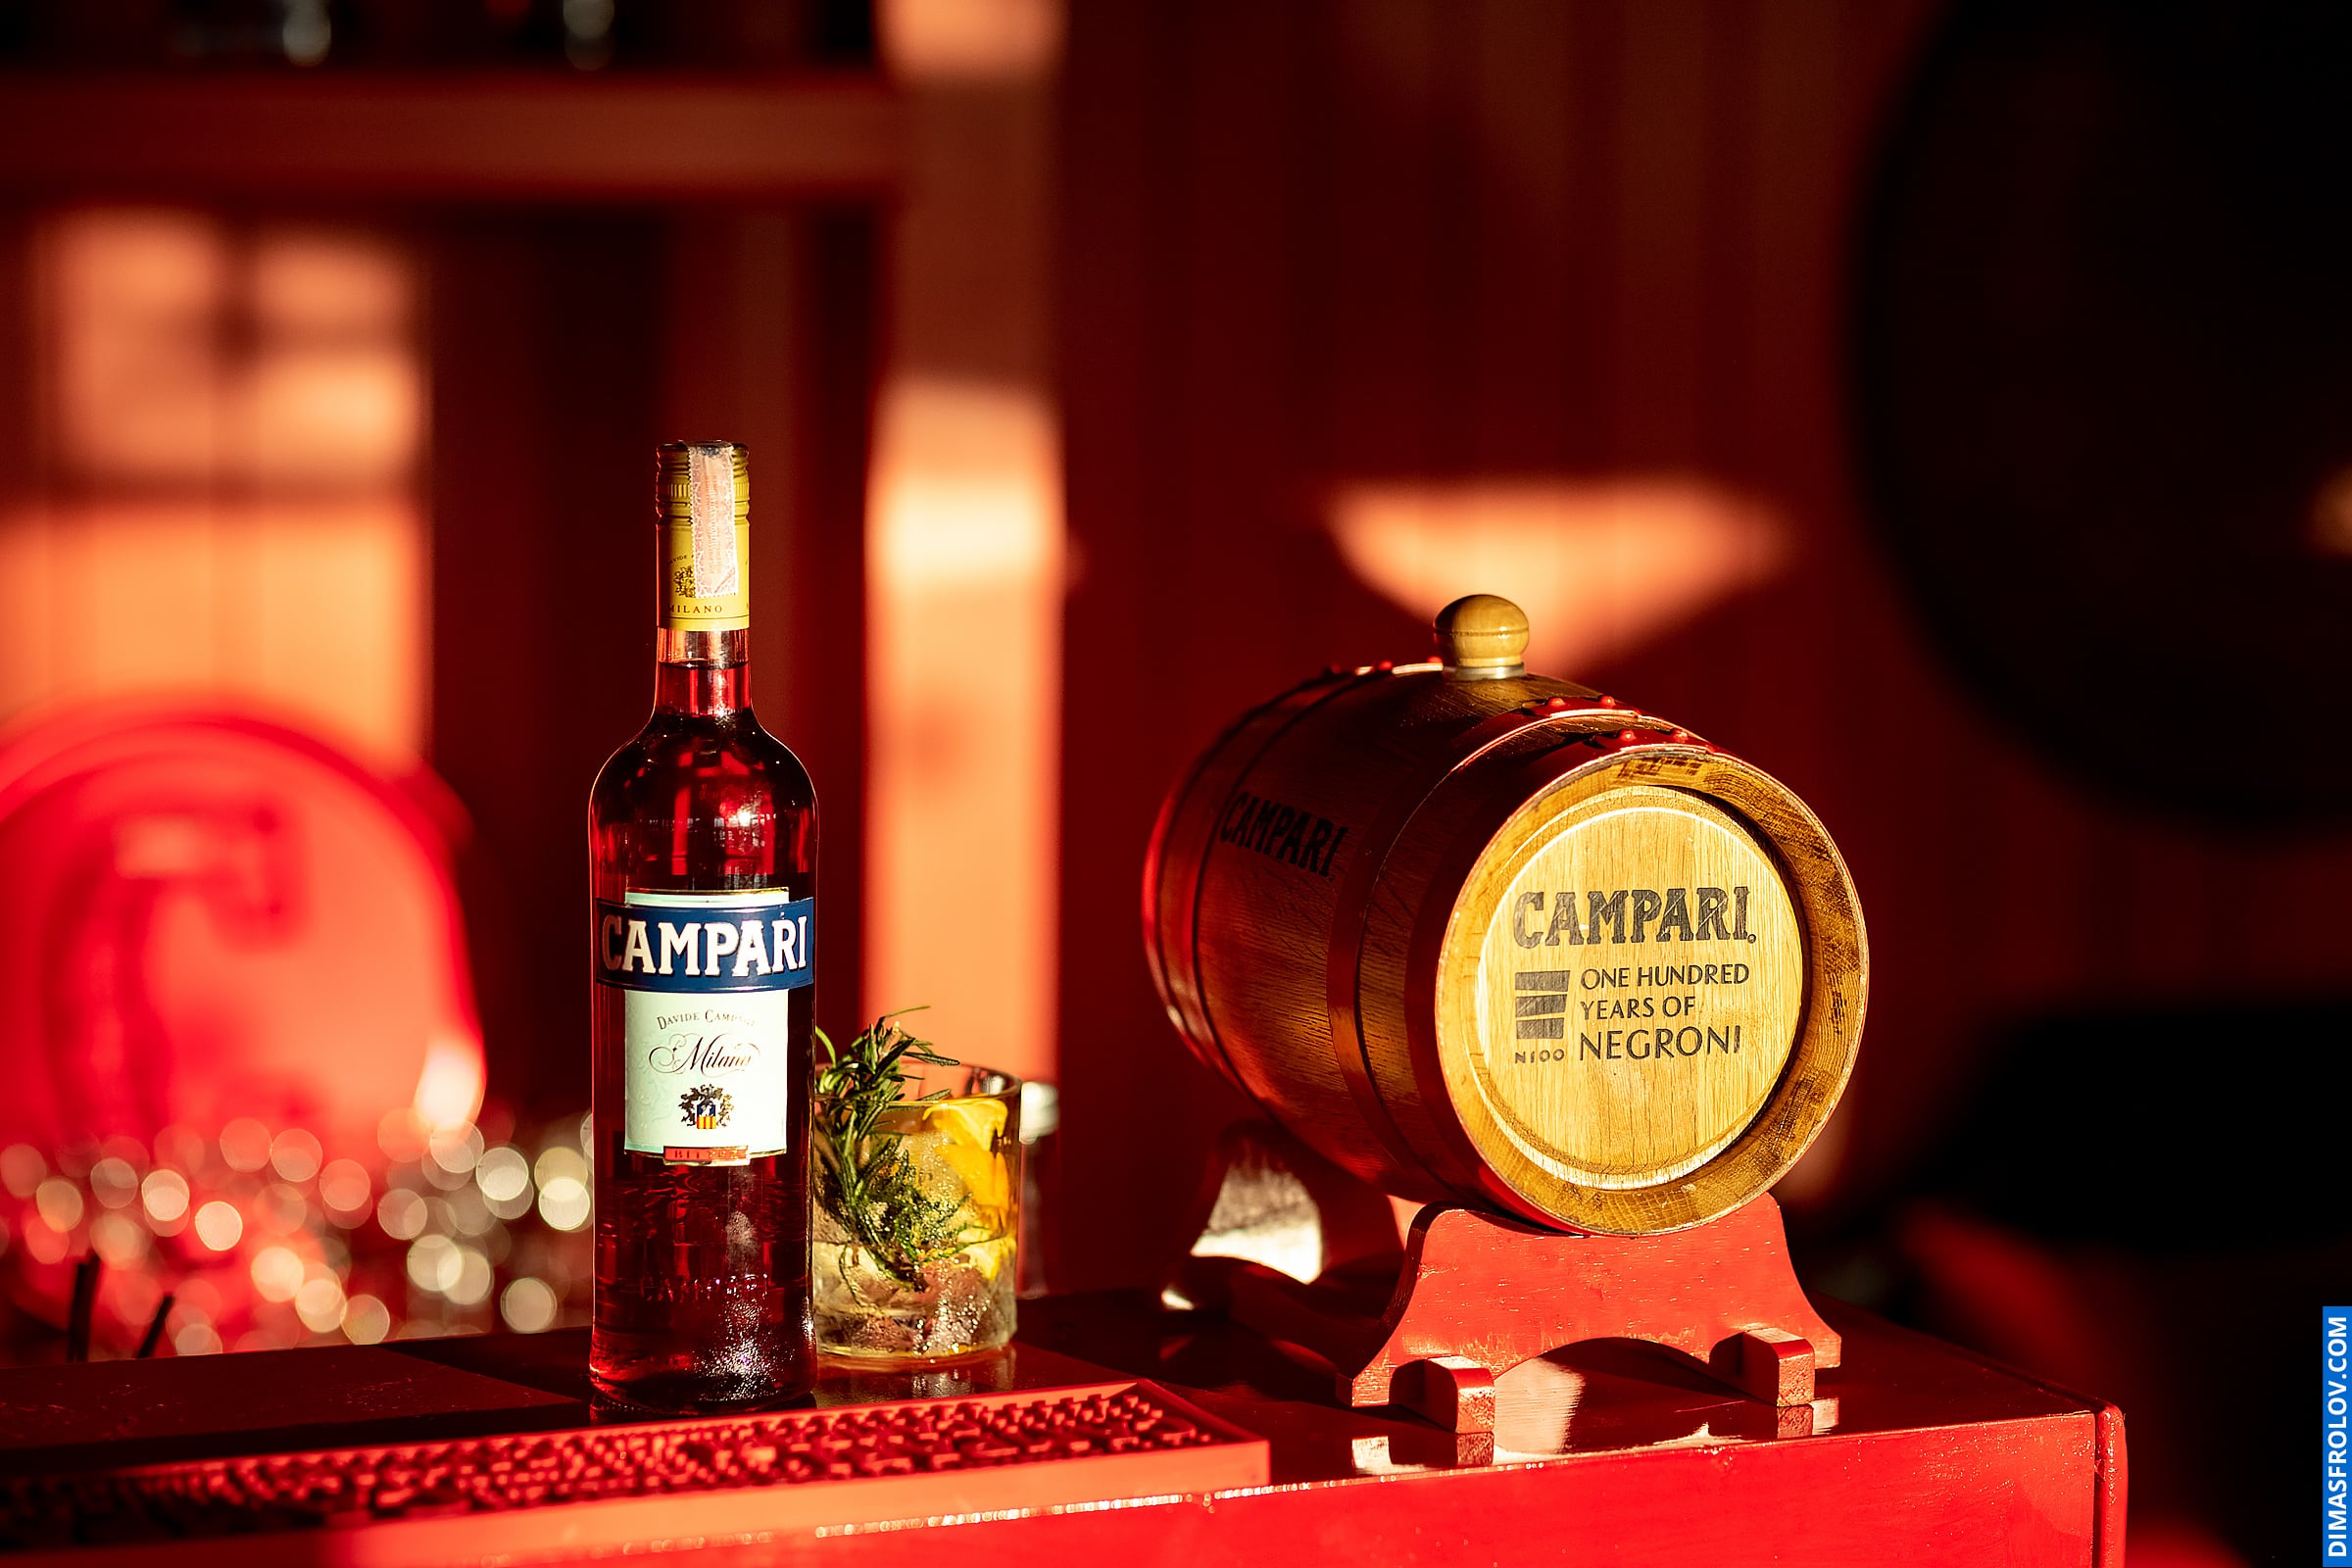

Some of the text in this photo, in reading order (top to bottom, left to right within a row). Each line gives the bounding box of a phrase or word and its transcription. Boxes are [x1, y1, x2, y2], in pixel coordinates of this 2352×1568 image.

[667, 604, 723, 613] MILANO
[1219, 791, 1349, 877] CAMPARI
[602, 913, 808, 977] CAMPARI
[1580, 963, 1750, 991] ONE HUNDRED
[1580, 996, 1696, 1020] YEARS OF
[649, 1032, 760, 1078] Milano
[1580, 1025, 1740, 1061] NEGRONI
